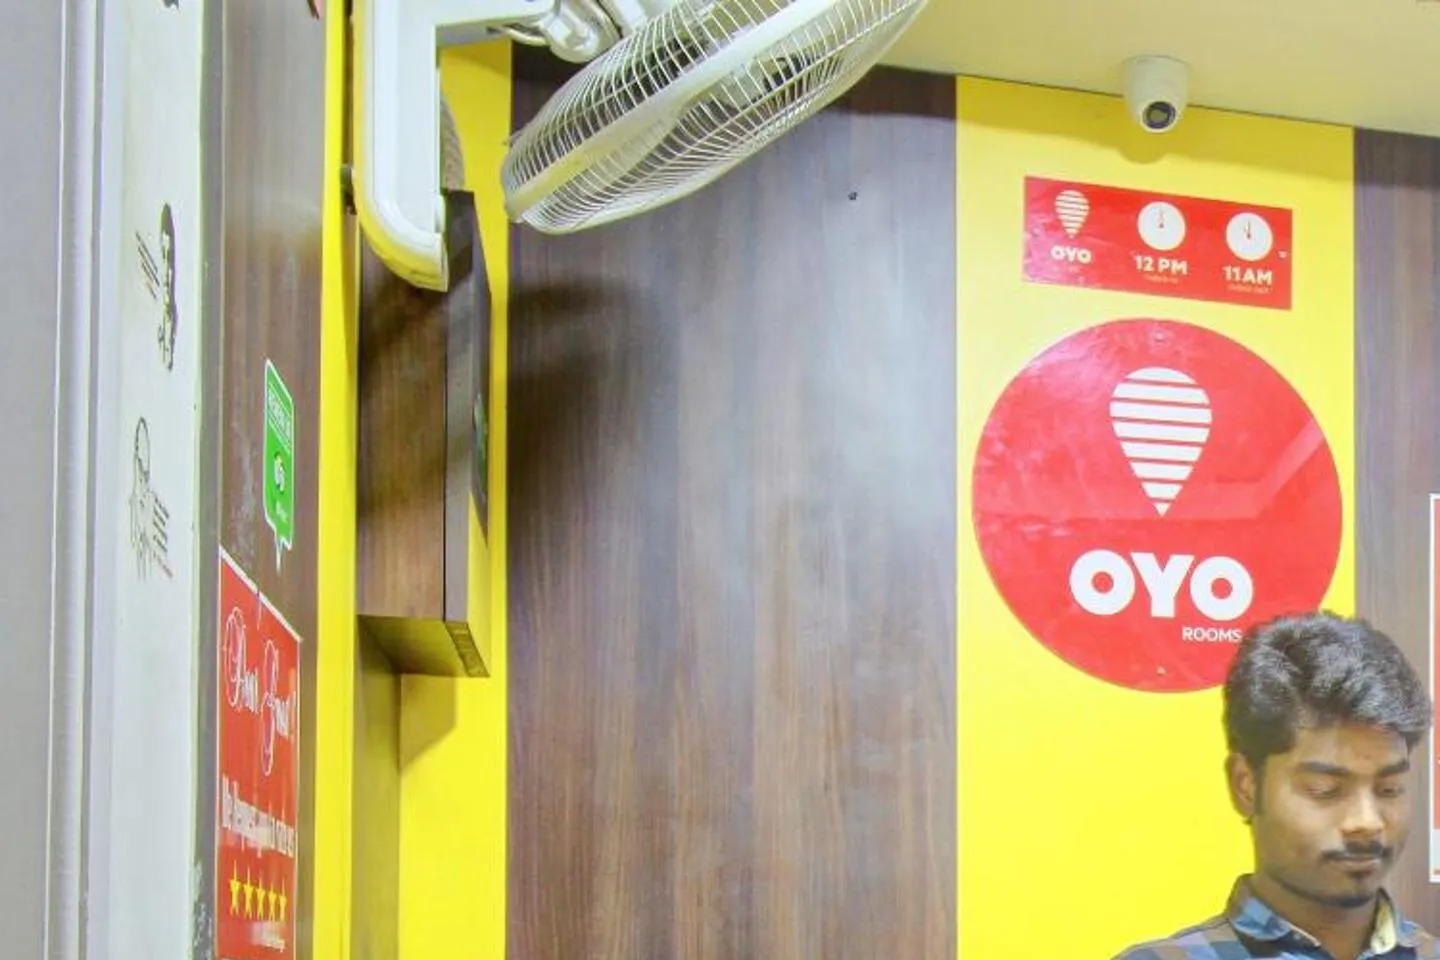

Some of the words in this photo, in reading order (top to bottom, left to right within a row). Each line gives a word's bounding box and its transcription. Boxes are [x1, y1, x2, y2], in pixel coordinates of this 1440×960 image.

[1050, 245, 1092, 264] OYO
[1135, 255, 1154, 272] 12
[1158, 258, 1188, 275] PM
[1069, 548, 1254, 621] OYO
[1182, 626, 1242, 643] ROOMS
